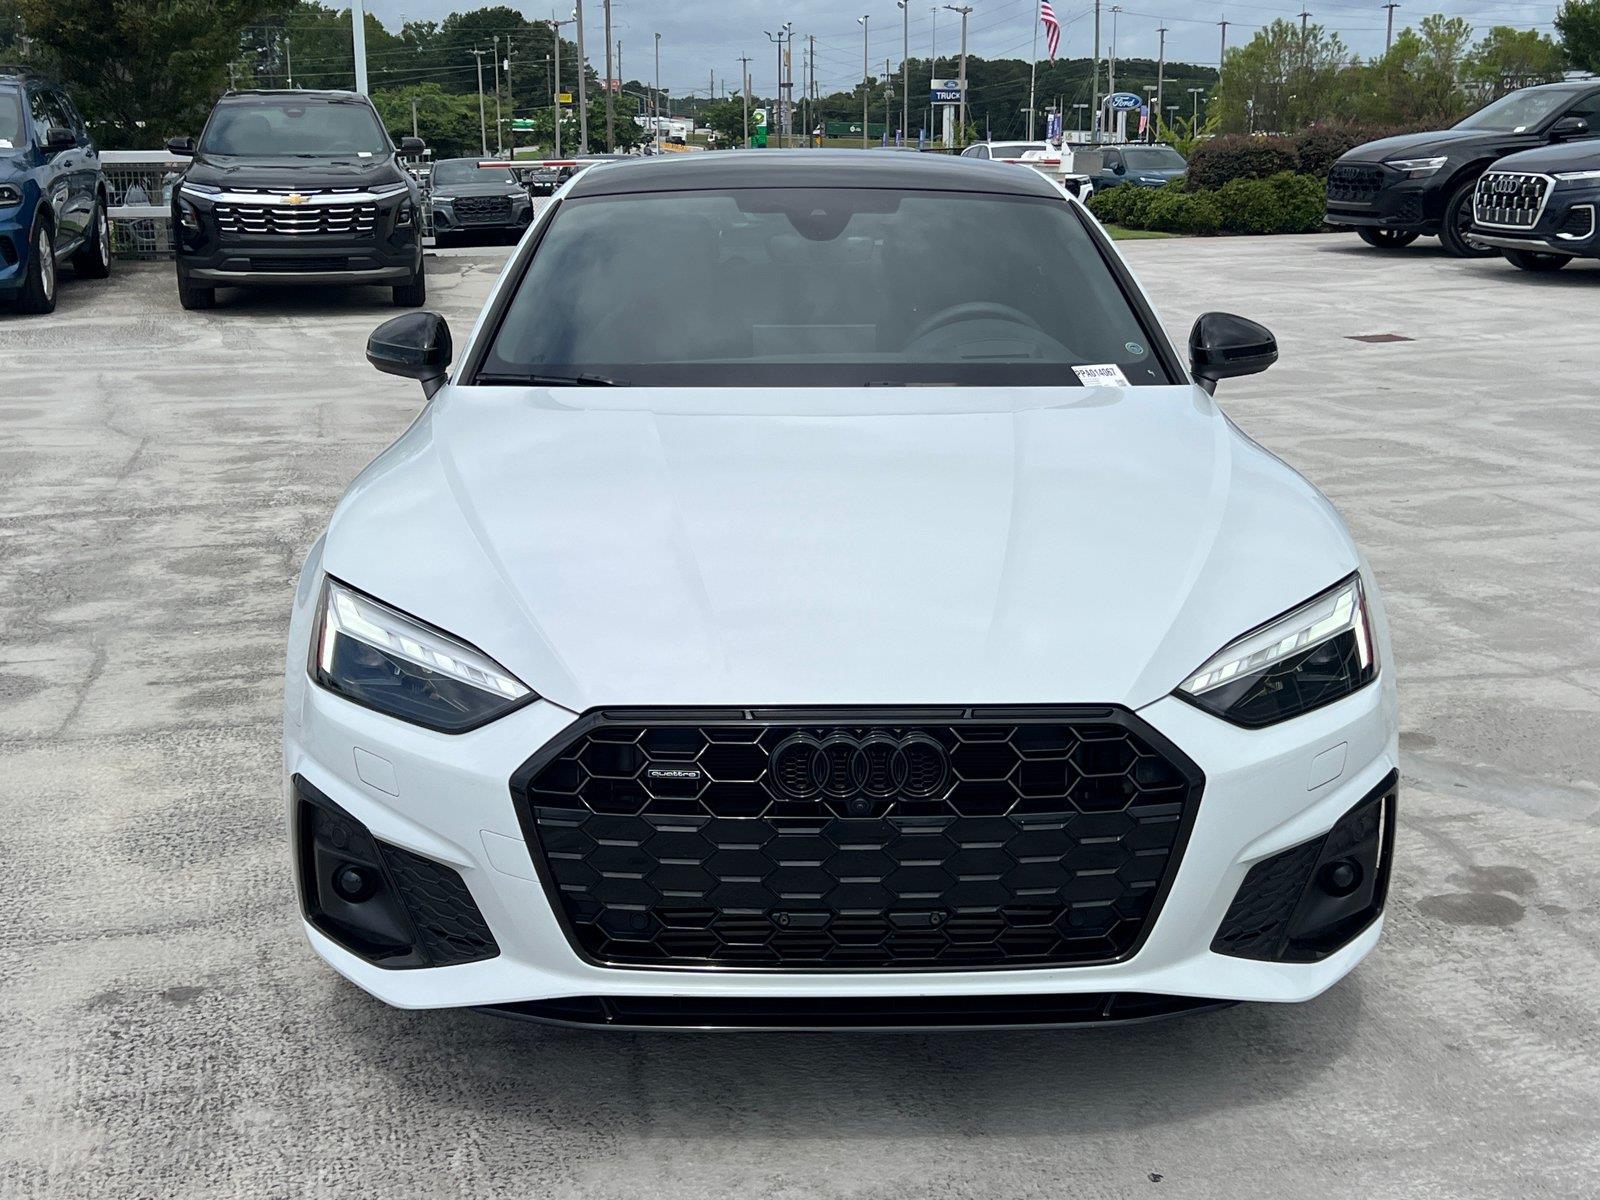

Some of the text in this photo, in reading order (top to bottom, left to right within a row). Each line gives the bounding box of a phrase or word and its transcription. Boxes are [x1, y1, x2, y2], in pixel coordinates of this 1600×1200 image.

[936, 92, 961, 100] TRUCK
[1112, 96, 1135, 107] Ford
[651, 770, 697, 778] quattro
